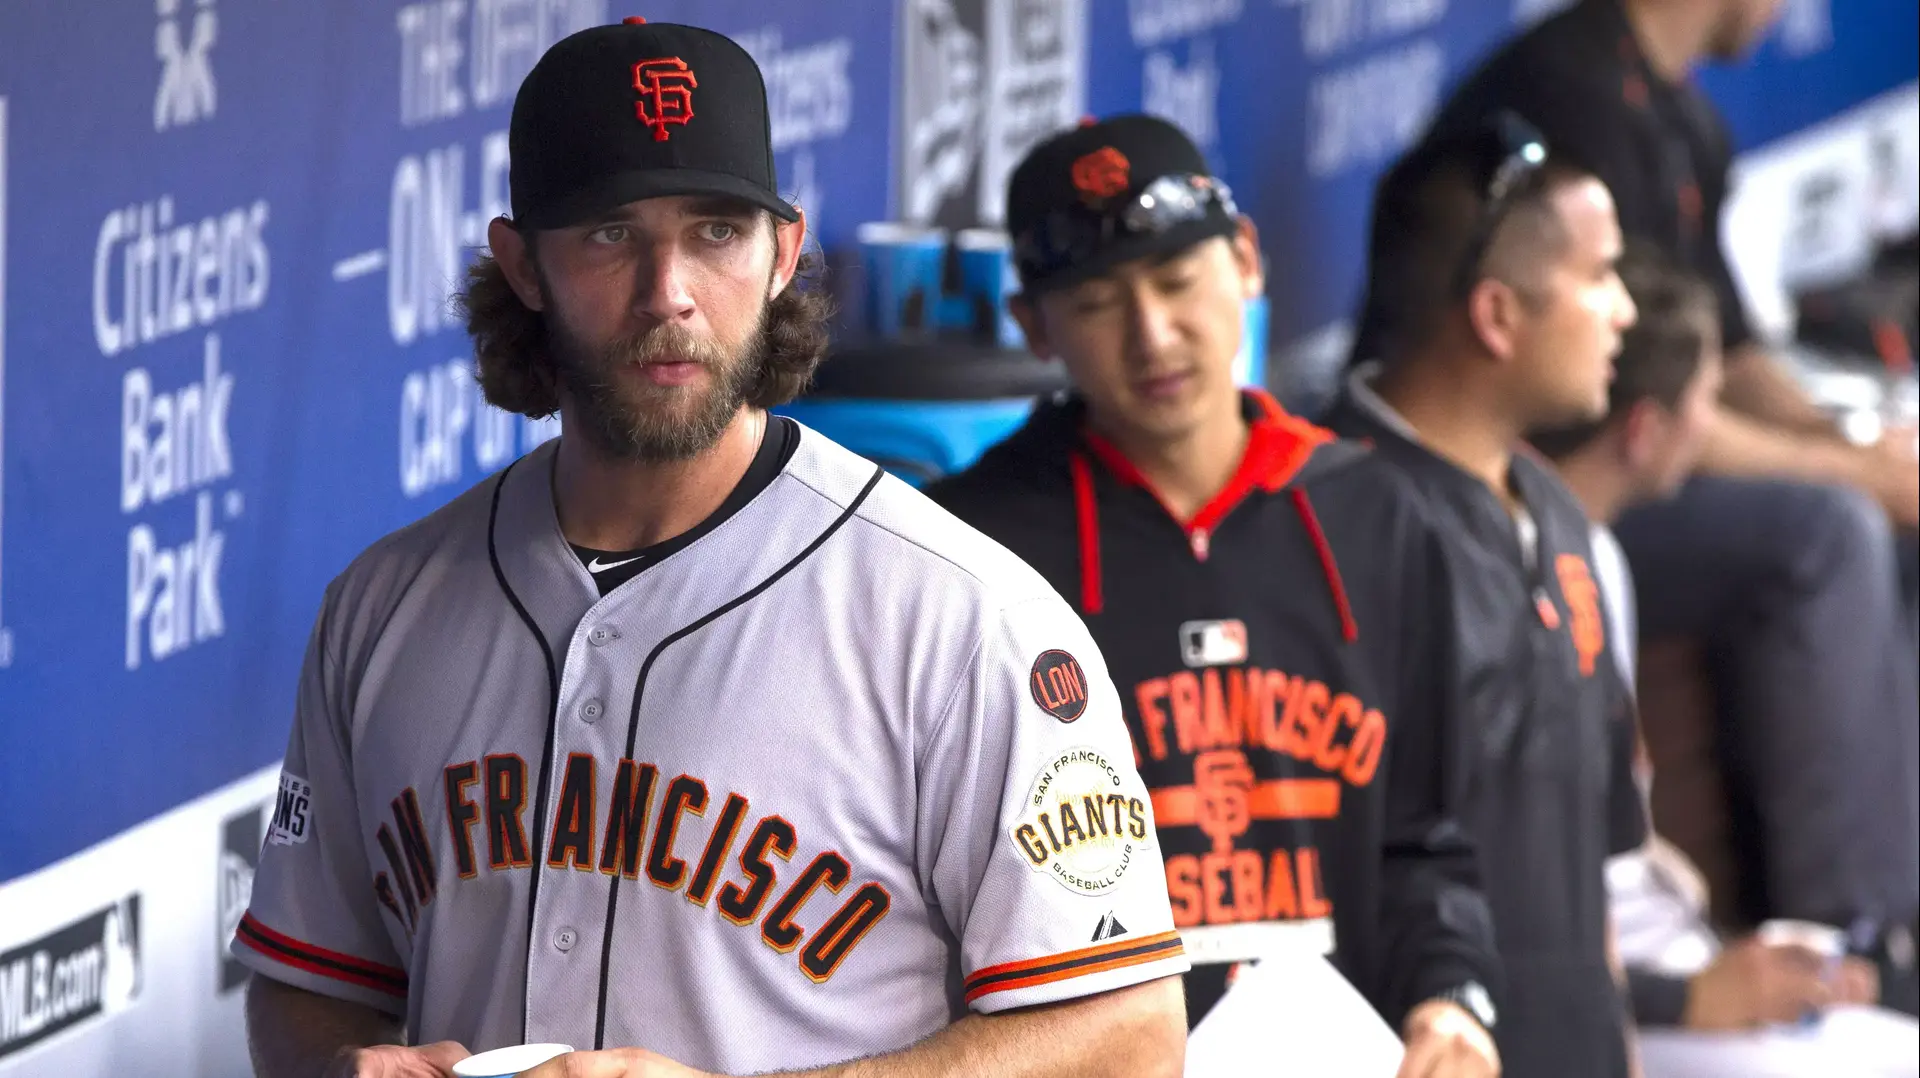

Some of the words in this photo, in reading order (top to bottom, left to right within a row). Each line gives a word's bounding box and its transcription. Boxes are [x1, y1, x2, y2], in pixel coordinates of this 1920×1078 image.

[631, 57, 697, 141] SF
[93, 195, 269, 356] Citizens
[121, 332, 235, 513] Bank
[125, 490, 225, 671] Park
[1036, 661, 1084, 709] LON
[1135, 668, 1387, 787] FRANCISCO
[1034, 772, 1053, 805] SAN
[1053, 751, 1121, 786] FRANCISCO
[444, 752, 891, 983] FRANCISCO
[1015, 794, 1147, 866] GIANTS
[1053, 862, 1115, 890] BASEBALL
[1115, 844, 1132, 877] CLUB
